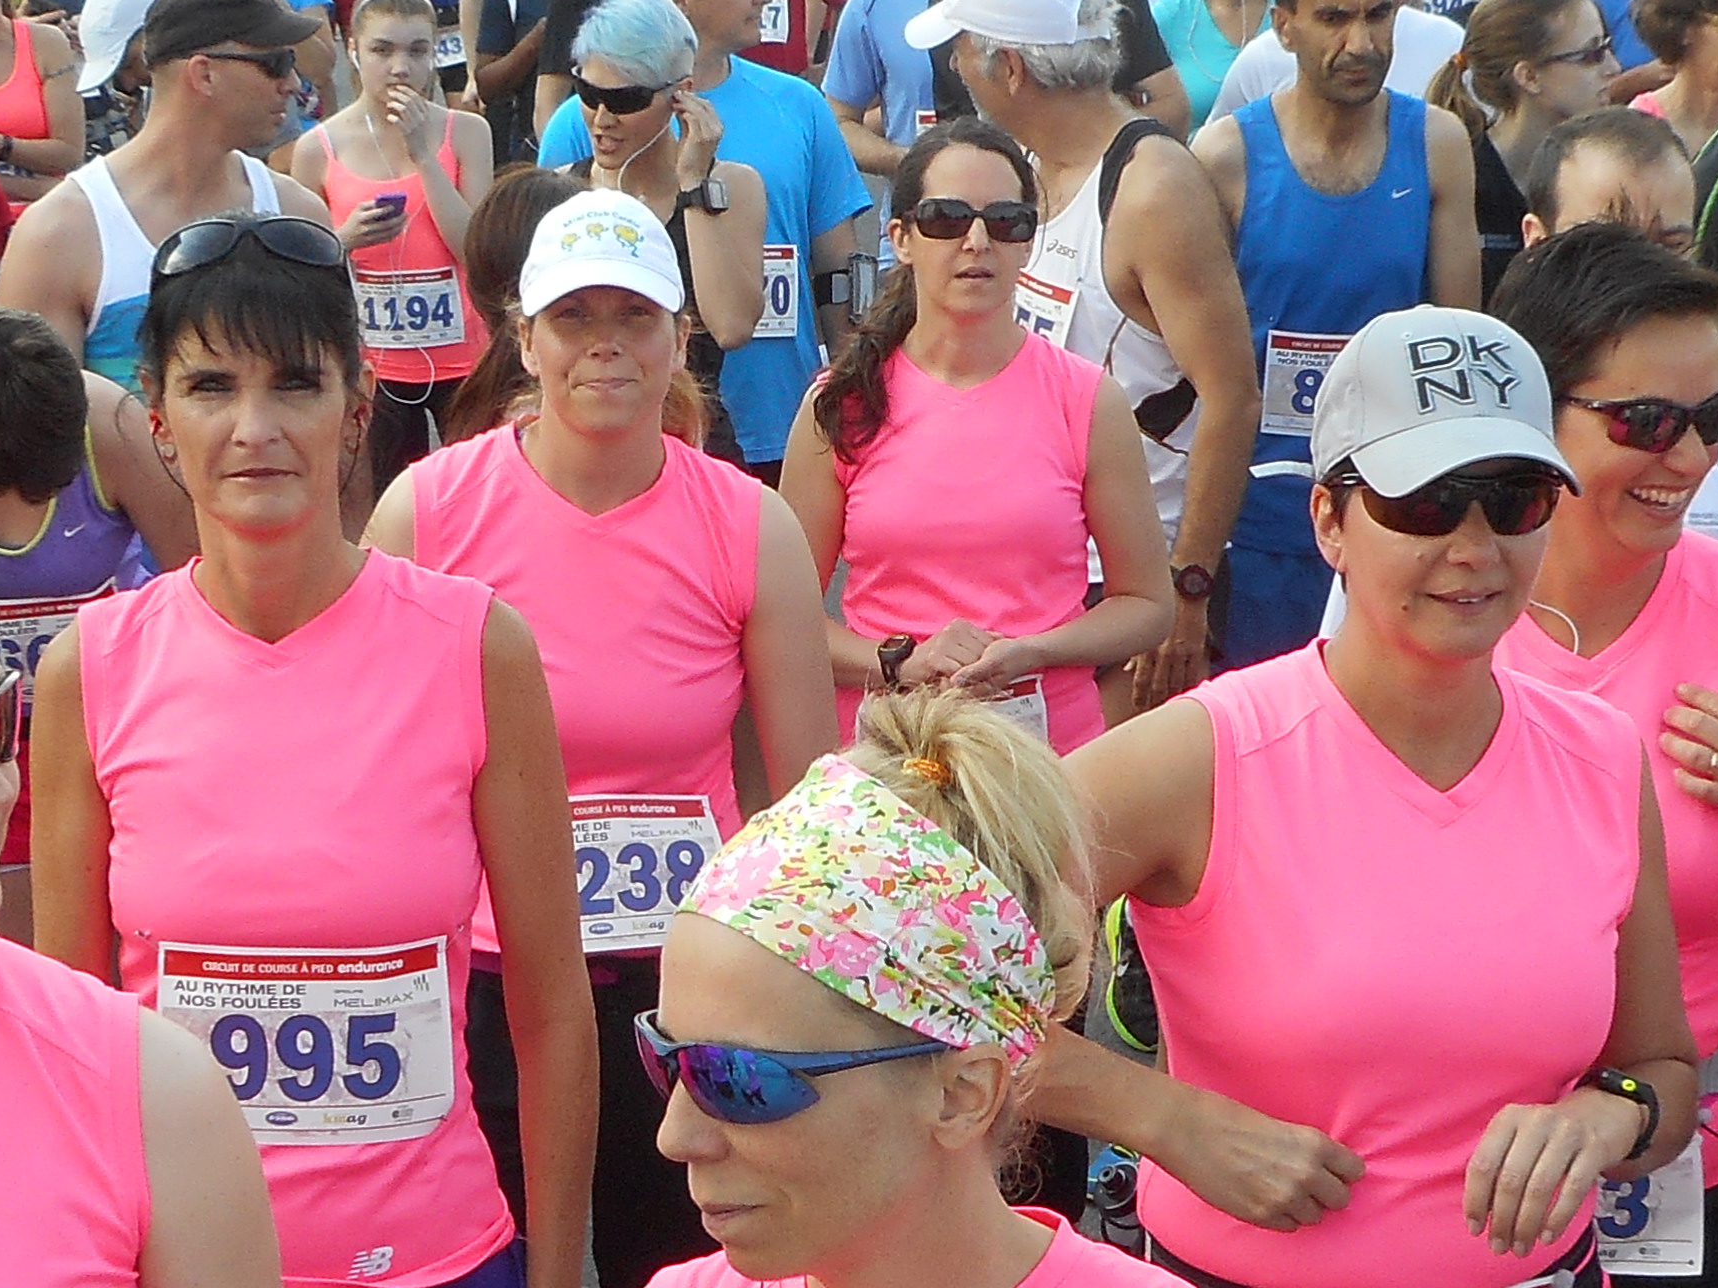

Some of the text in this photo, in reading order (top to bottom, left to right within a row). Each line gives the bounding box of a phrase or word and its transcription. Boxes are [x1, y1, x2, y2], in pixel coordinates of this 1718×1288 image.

[1055, 242, 1078, 259] asics
[363, 293, 454, 331] 1194
[629, 803, 676, 813] endurance
[594, 821, 611, 831] DE
[575, 839, 705, 916] 238
[202, 958, 404, 974] CIRCUIT DE COURSE À PIED endurance
[174, 980, 307, 996] AU RYTHME DE
[179, 992, 302, 1009] NOS FOULÉES
[210, 1012, 401, 1102] 995
